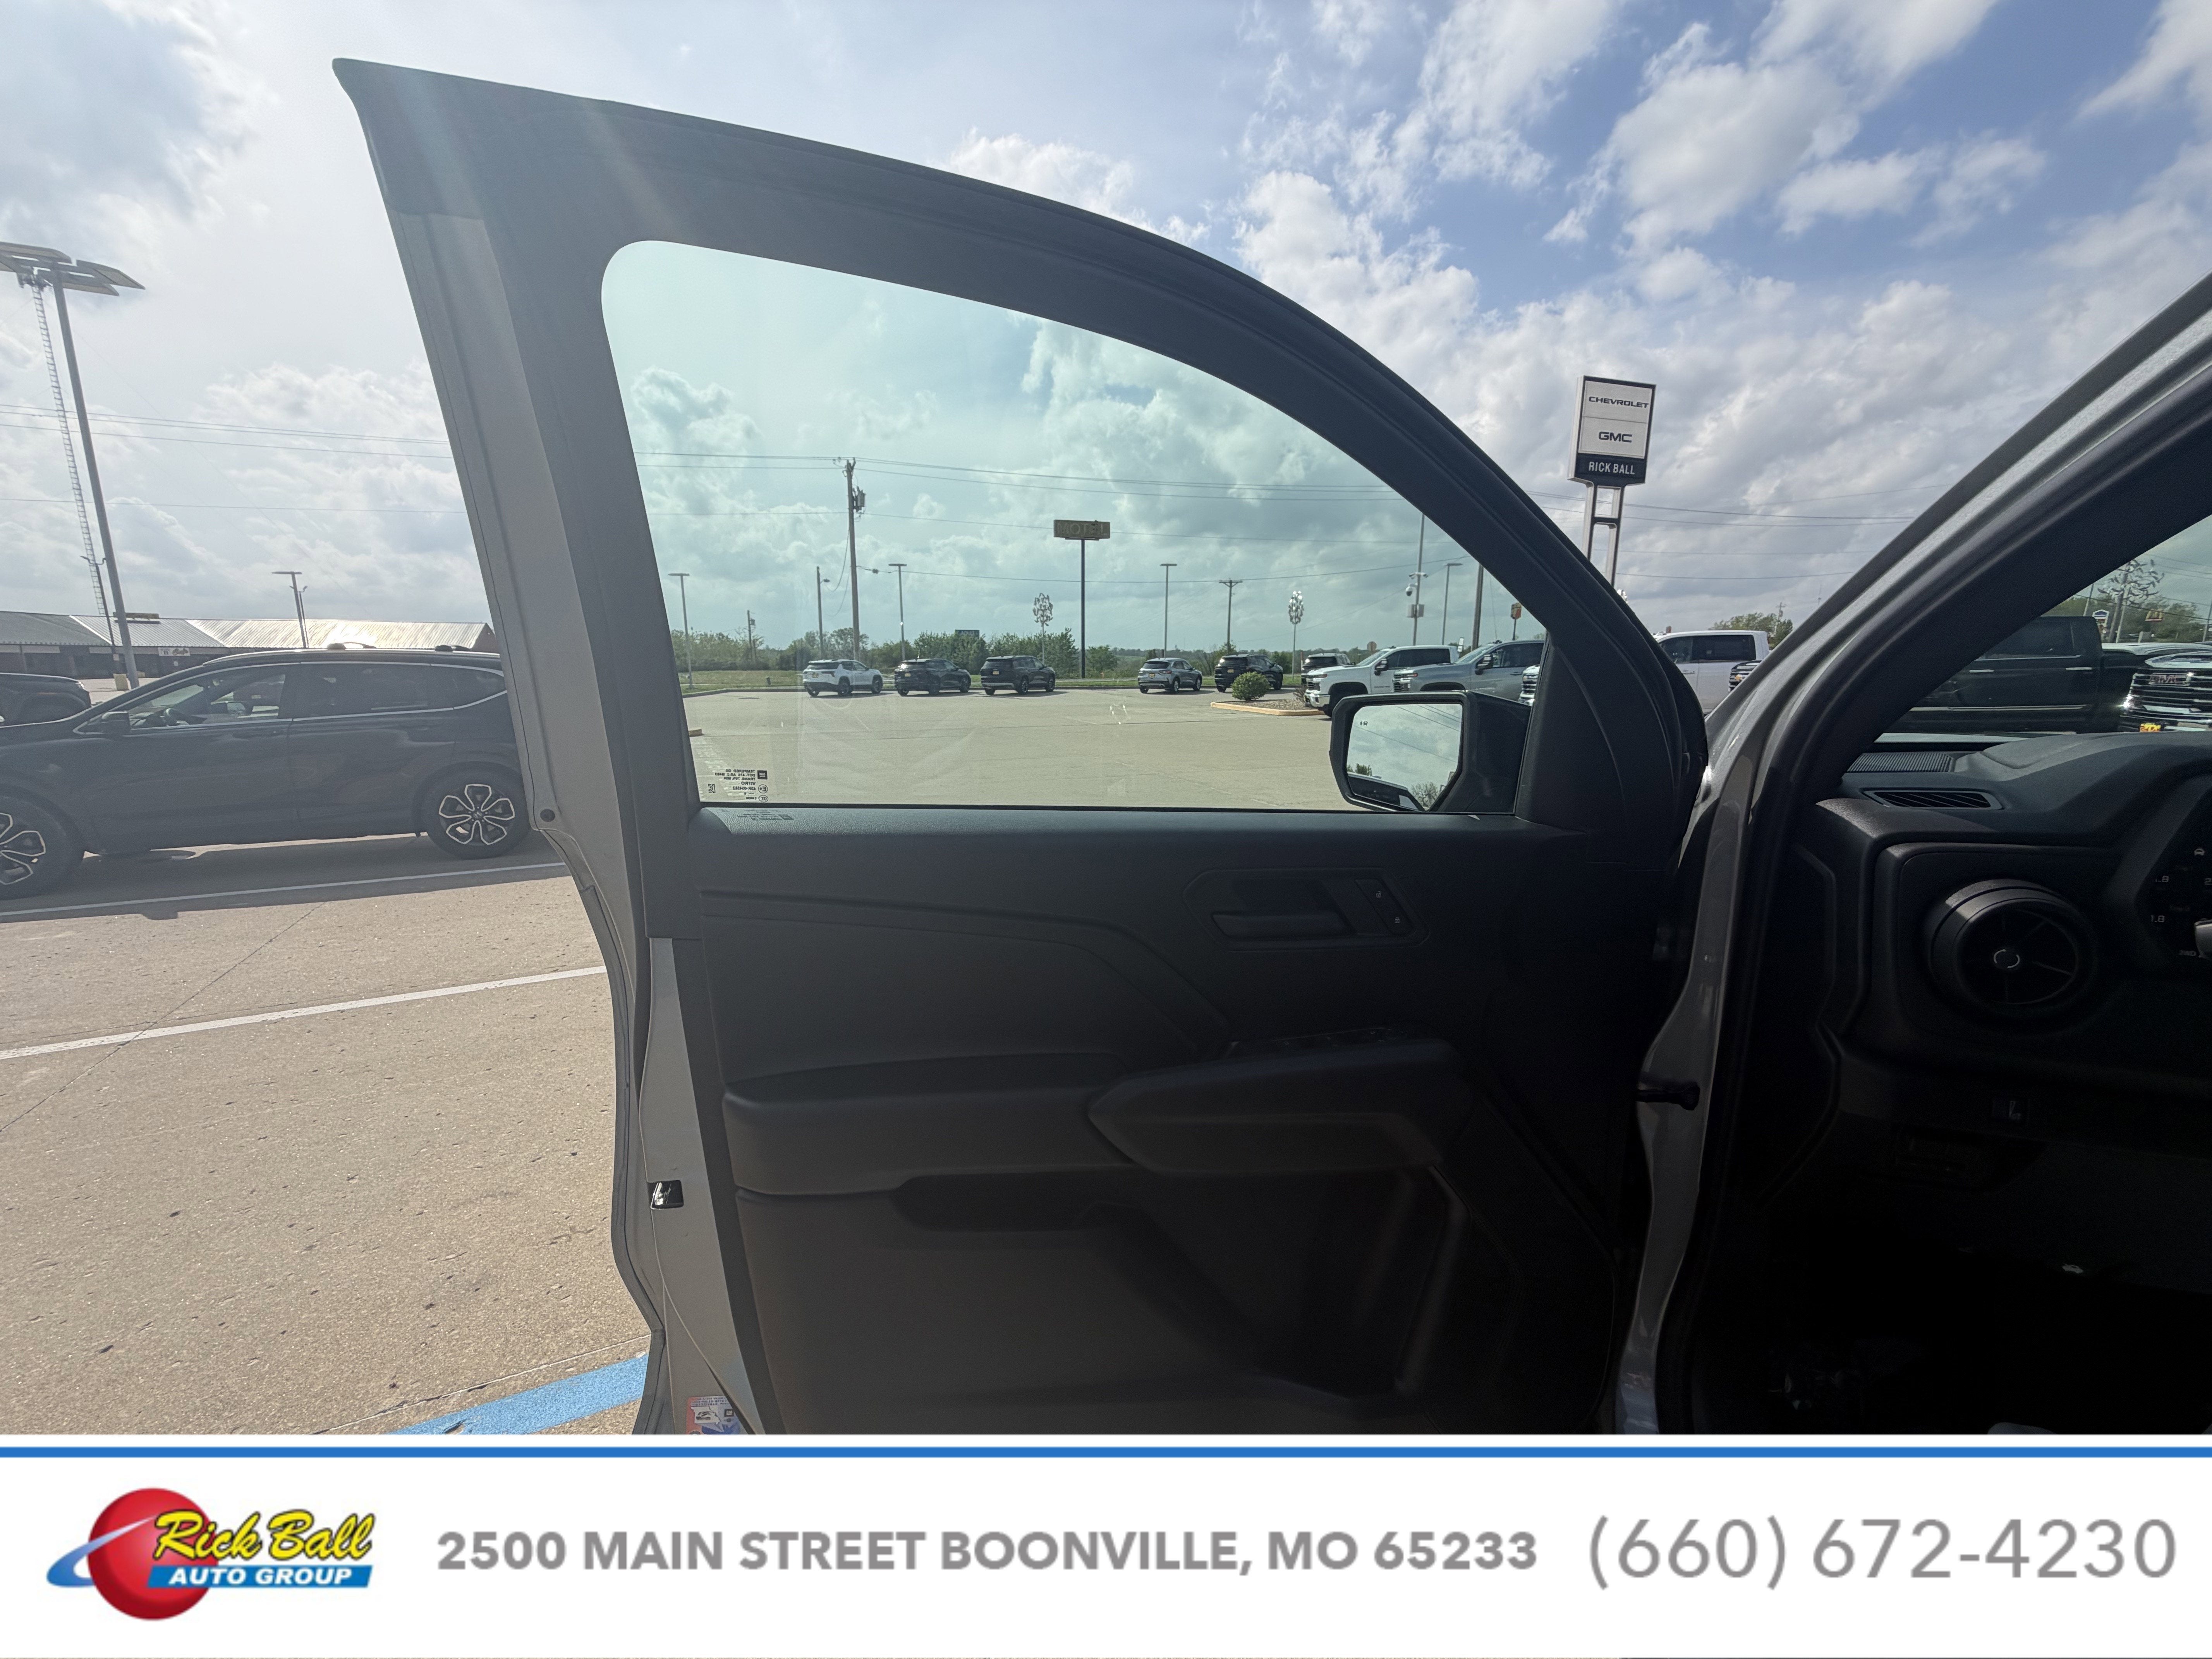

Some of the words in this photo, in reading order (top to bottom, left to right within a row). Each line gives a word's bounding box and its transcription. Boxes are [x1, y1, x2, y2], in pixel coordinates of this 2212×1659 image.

[1589, 396, 1649, 408] CHEVROLET
[1599, 431, 1633, 443] GMC
[1589, 461, 1611, 473] RICK
[1613, 464, 1635, 475] BALL
